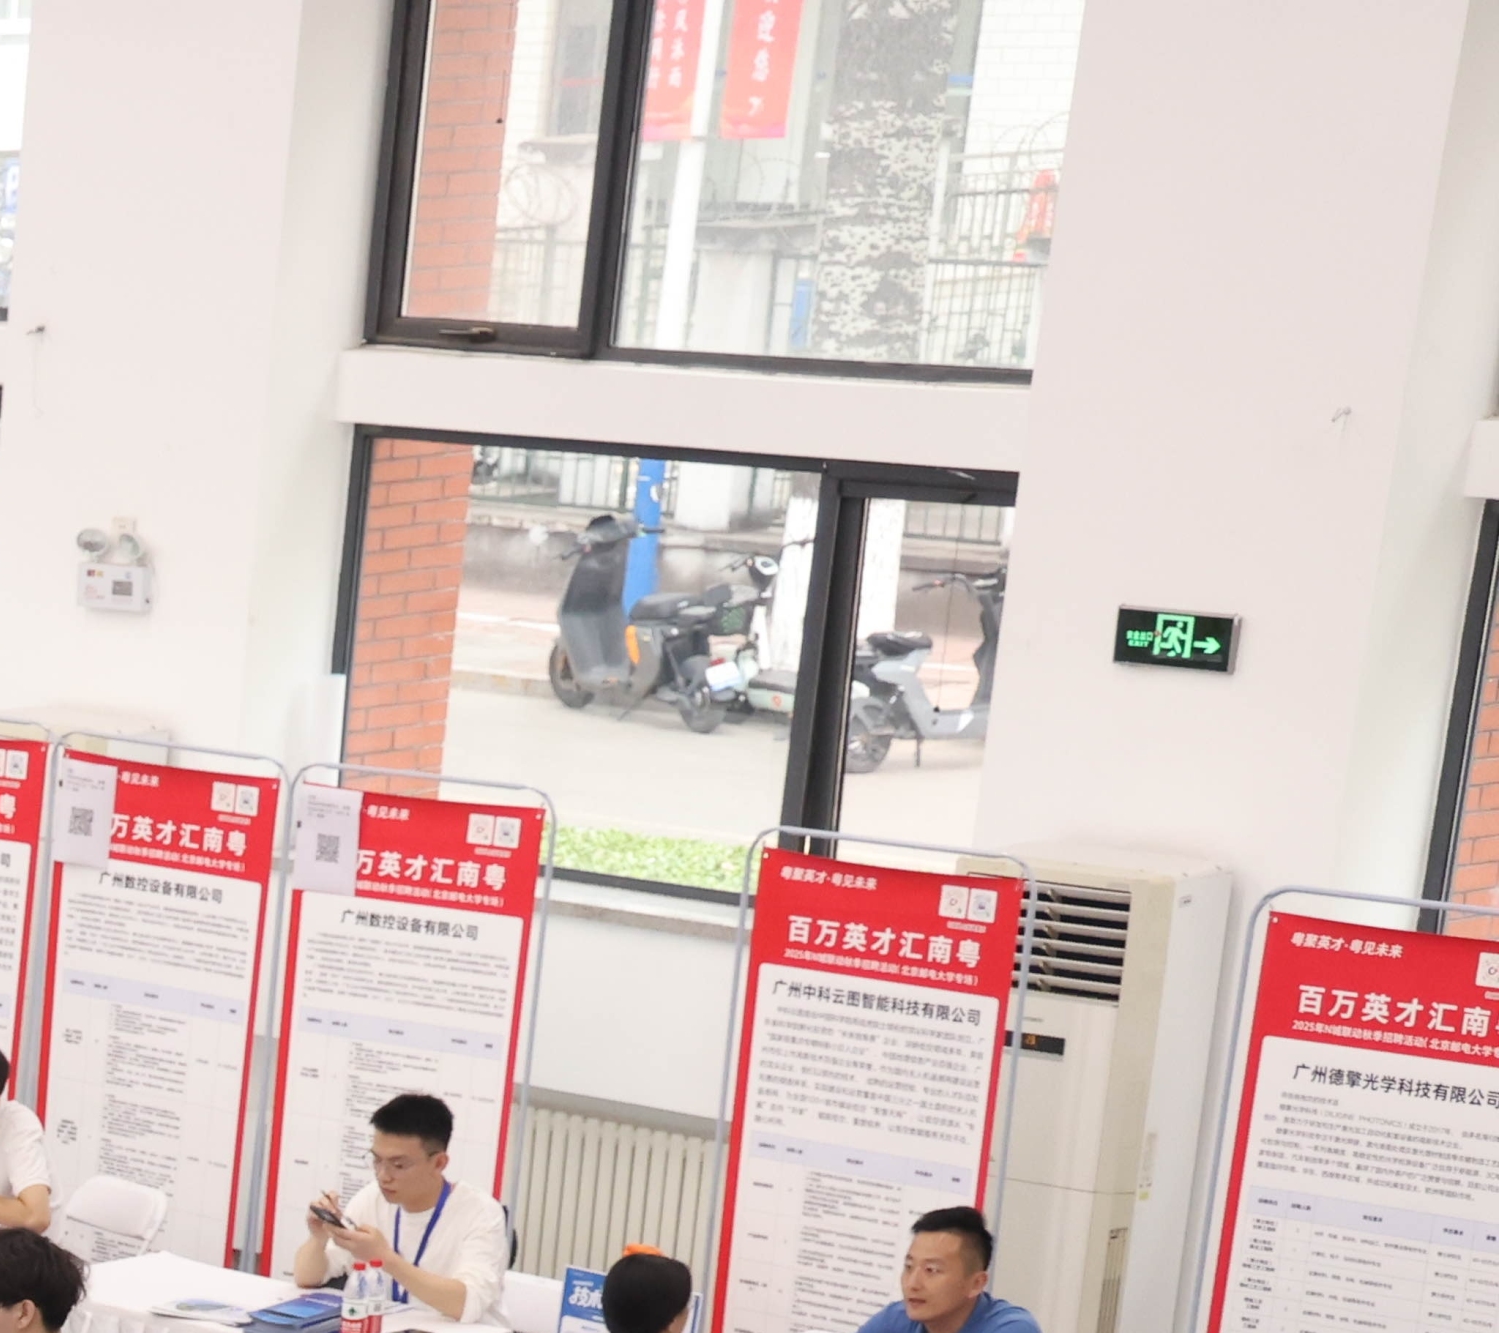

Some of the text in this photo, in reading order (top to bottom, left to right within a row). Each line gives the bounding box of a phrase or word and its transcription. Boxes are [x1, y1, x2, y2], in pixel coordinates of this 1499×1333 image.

[108, 812, 248, 858] 万英才汇南粤
[98, 872, 224, 905] 广州数控设备有限公司
[355, 847, 508, 892] 万英才汇南粤
[340, 908, 480, 942] 广州数控设备有限公司
[787, 913, 982, 970] 百万英才汇南粤
[1290, 931, 1404, 959] 粤聚英才·粤见未来
[771, 979, 982, 1027] 广州中科云图智能科技有限公司
[1297, 984, 1499, 1042] 百万英才汇南
[1292, 1063, 1499, 1111] 广州德擎光学科技有限公司
